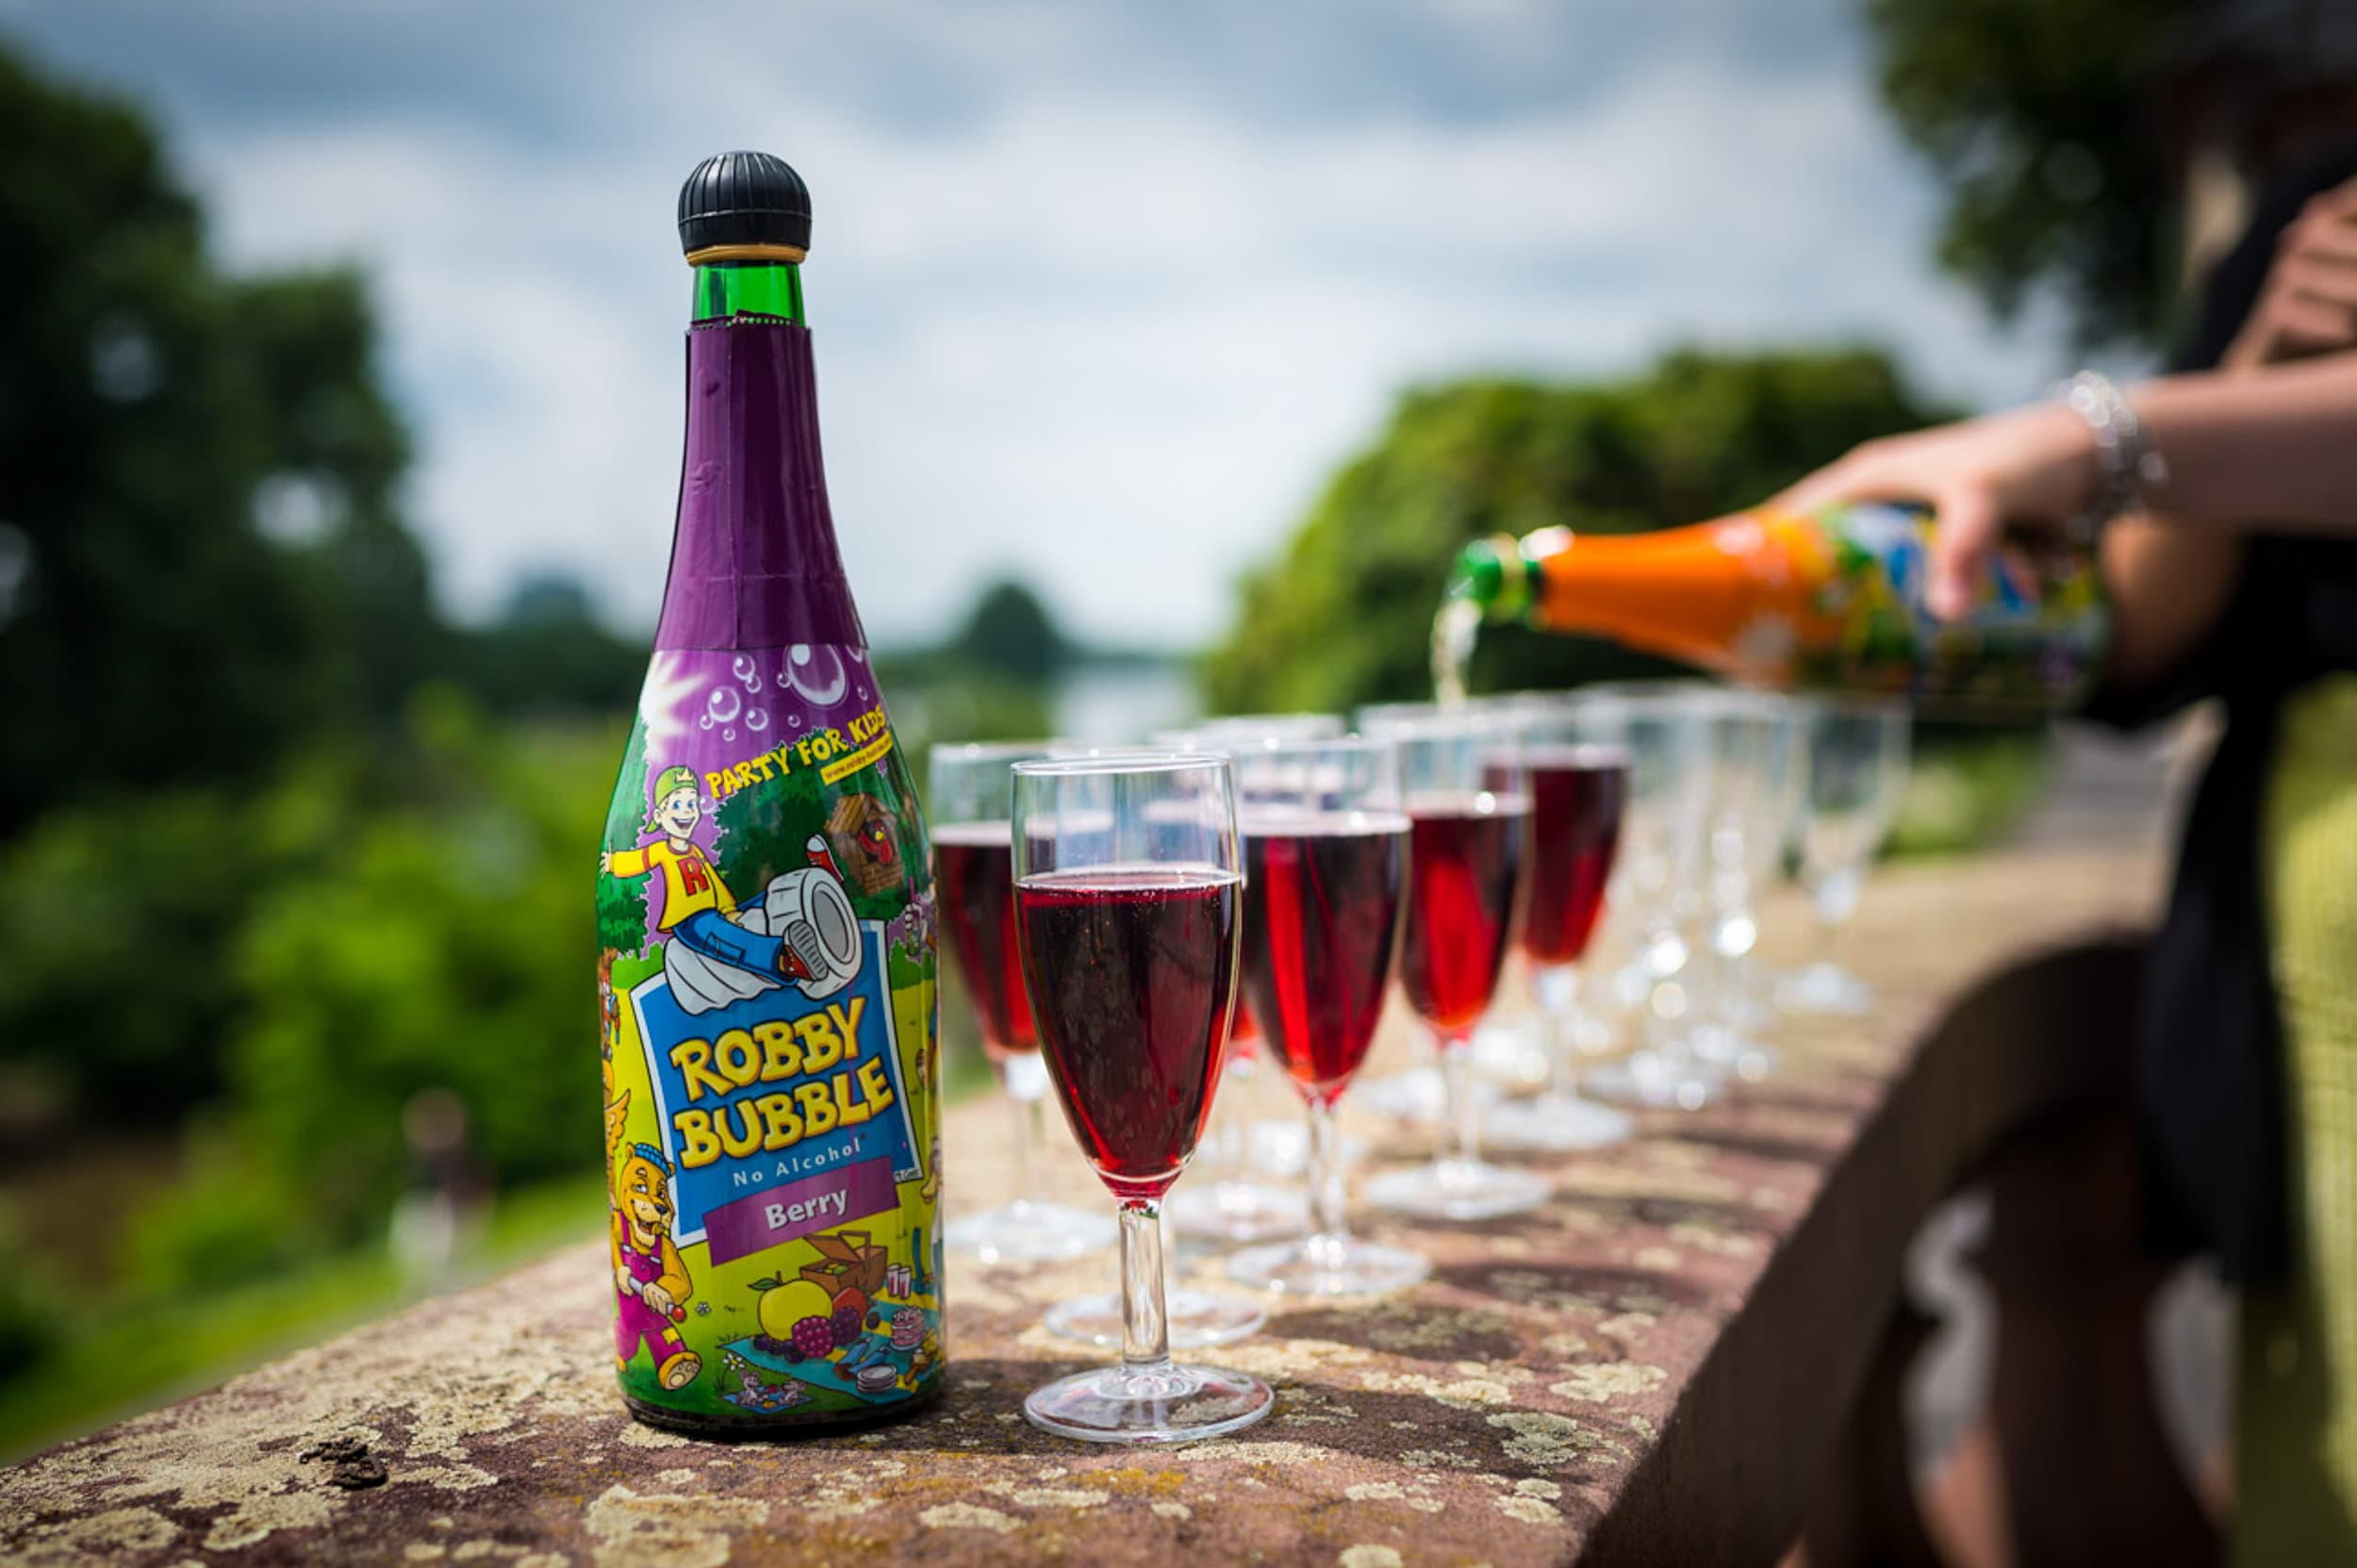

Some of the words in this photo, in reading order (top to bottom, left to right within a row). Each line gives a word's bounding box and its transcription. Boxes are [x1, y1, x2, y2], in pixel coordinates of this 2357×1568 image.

[705, 747, 790, 799] PARTY
[796, 728, 849, 766] FOR
[848, 704, 886, 744] KIDS
[677, 855, 709, 897] R
[668, 996, 866, 1102] ROBBY
[673, 1055, 896, 1169] BUBBLE
[733, 1171, 764, 1187] No
[776, 1136, 861, 1178] Alcohol
[765, 1189, 849, 1230] Berry
